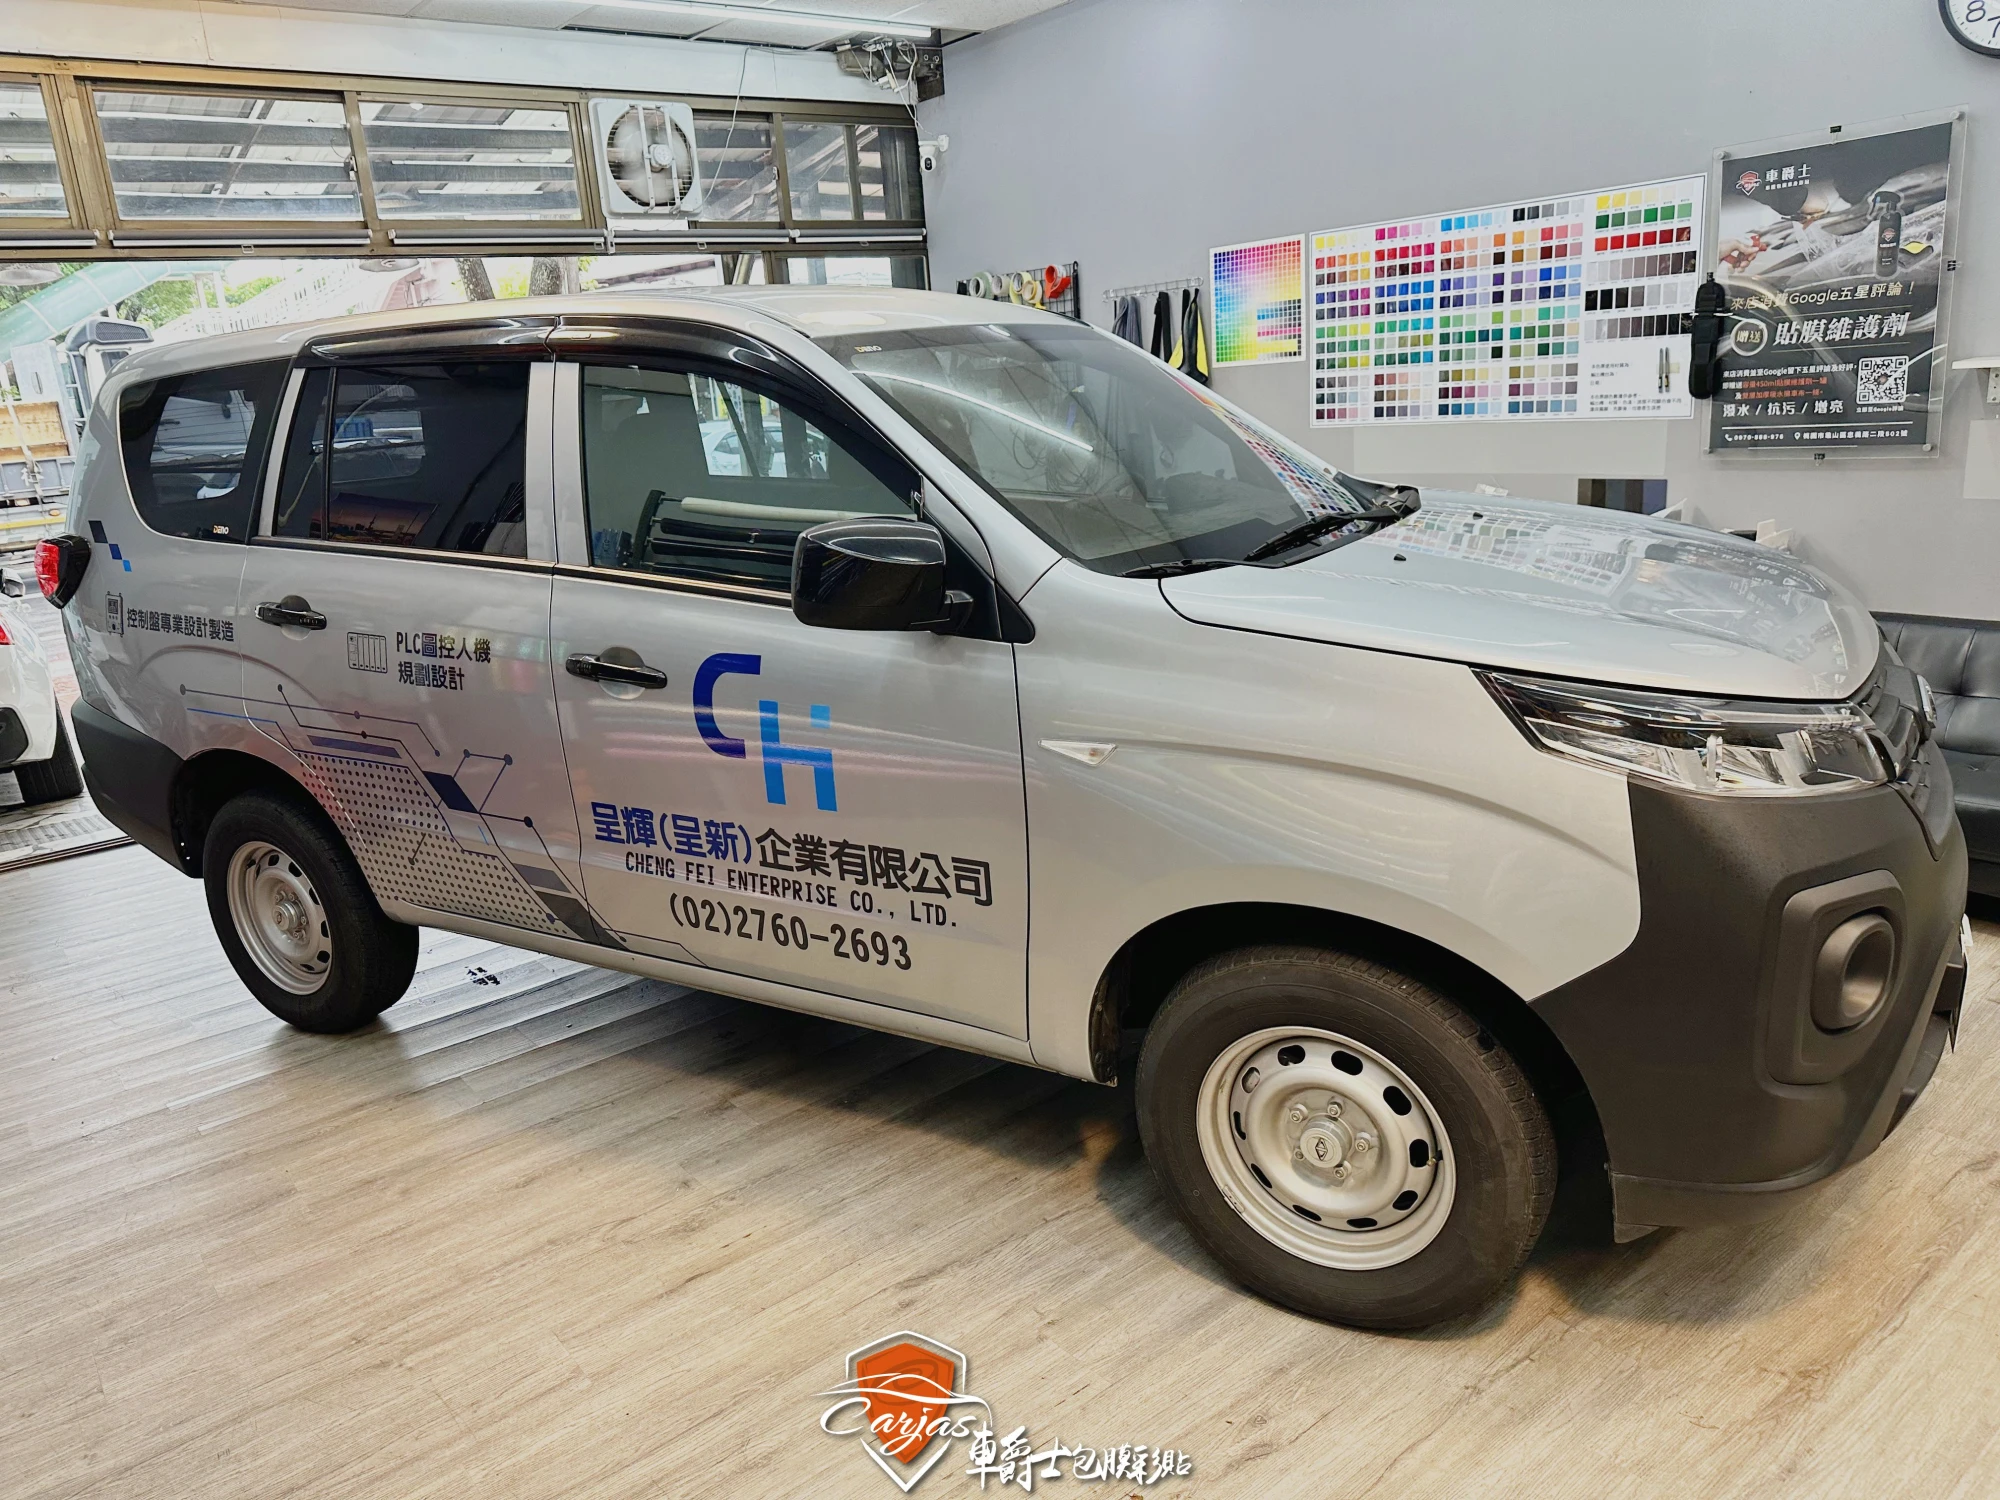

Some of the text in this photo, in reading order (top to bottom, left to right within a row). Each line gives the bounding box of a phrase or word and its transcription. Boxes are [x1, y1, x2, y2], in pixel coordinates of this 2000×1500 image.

[1966, 0, 1986, 23] 8
[1765, 163, 1812, 183] 車爵士
[1772, 311, 1912, 347] 貼膜維護劑
[1722, 403, 1750, 418] 潑水
[1767, 401, 1796, 416] 抗污
[1813, 400, 1844, 414] 增亮
[127, 608, 234, 642] 控制盤專業設計製造
[396, 631, 492, 664] PLC圖控人機
[398, 661, 465, 691] 規劃設計
[590, 801, 993, 907] 呈輝(呈新)企業有限公司
[625, 851, 958, 928] CHENG FEI ENTERPRISE CO., LTD.
[669, 892, 912, 971] (02)2760-2693
